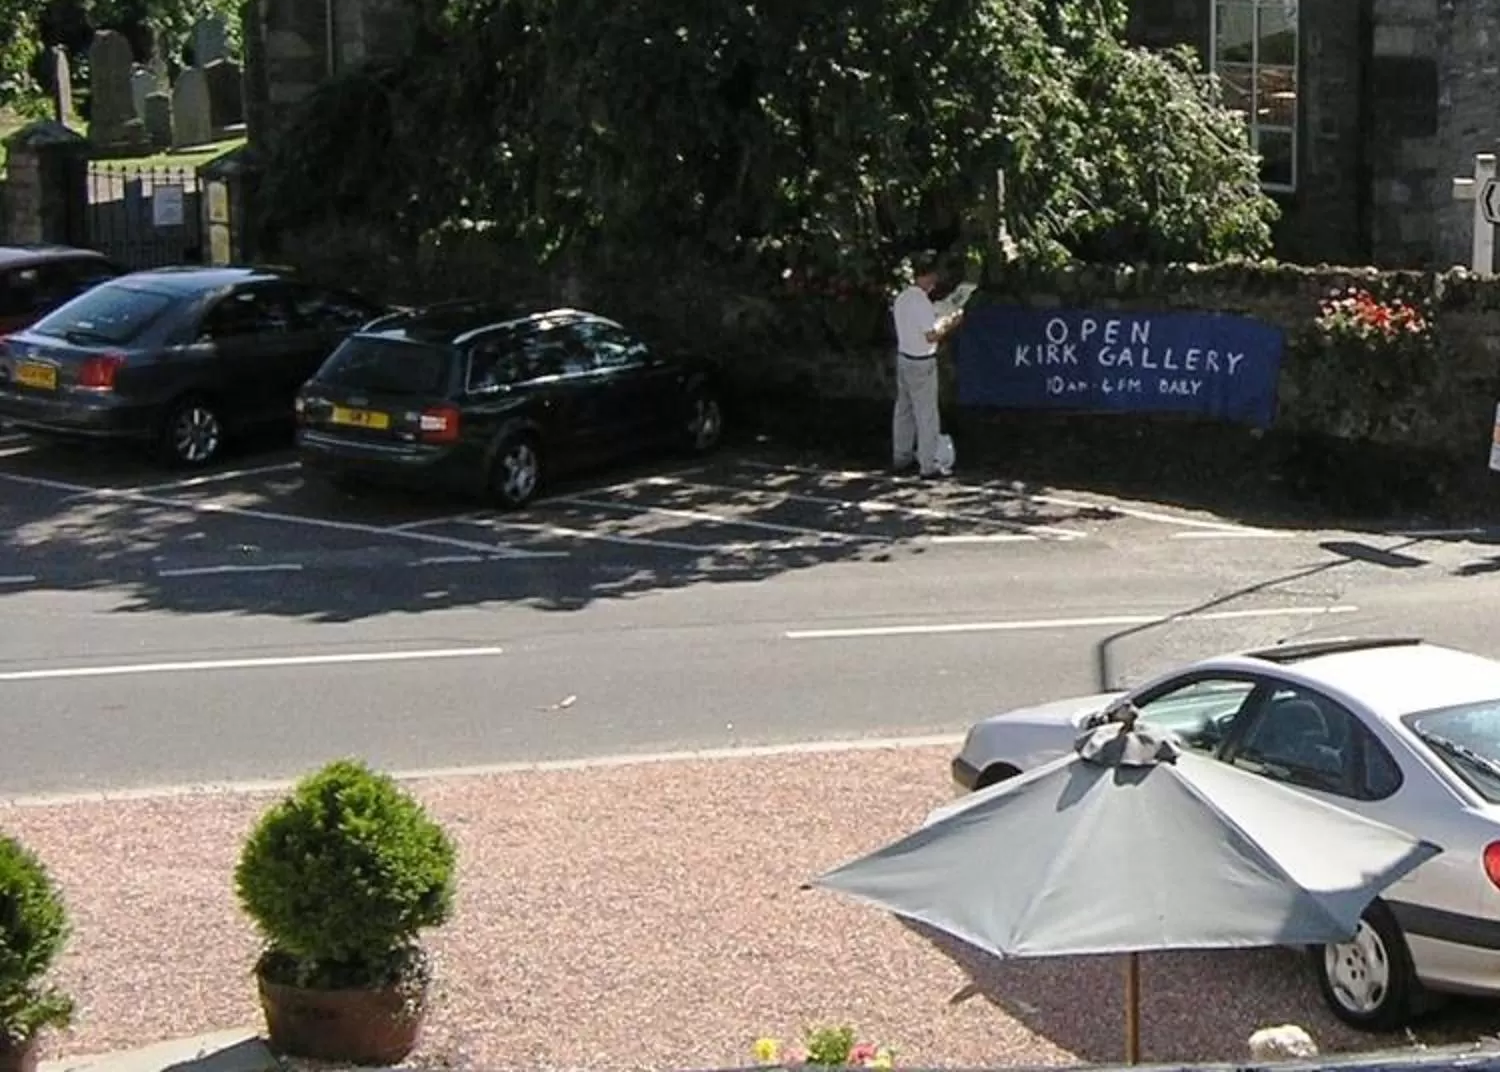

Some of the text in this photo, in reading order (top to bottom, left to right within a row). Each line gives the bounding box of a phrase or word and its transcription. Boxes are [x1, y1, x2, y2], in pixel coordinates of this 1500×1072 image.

[1046, 317, 1151, 345] OPEN
[1014, 343, 1244, 376] KIRK GALLERY
